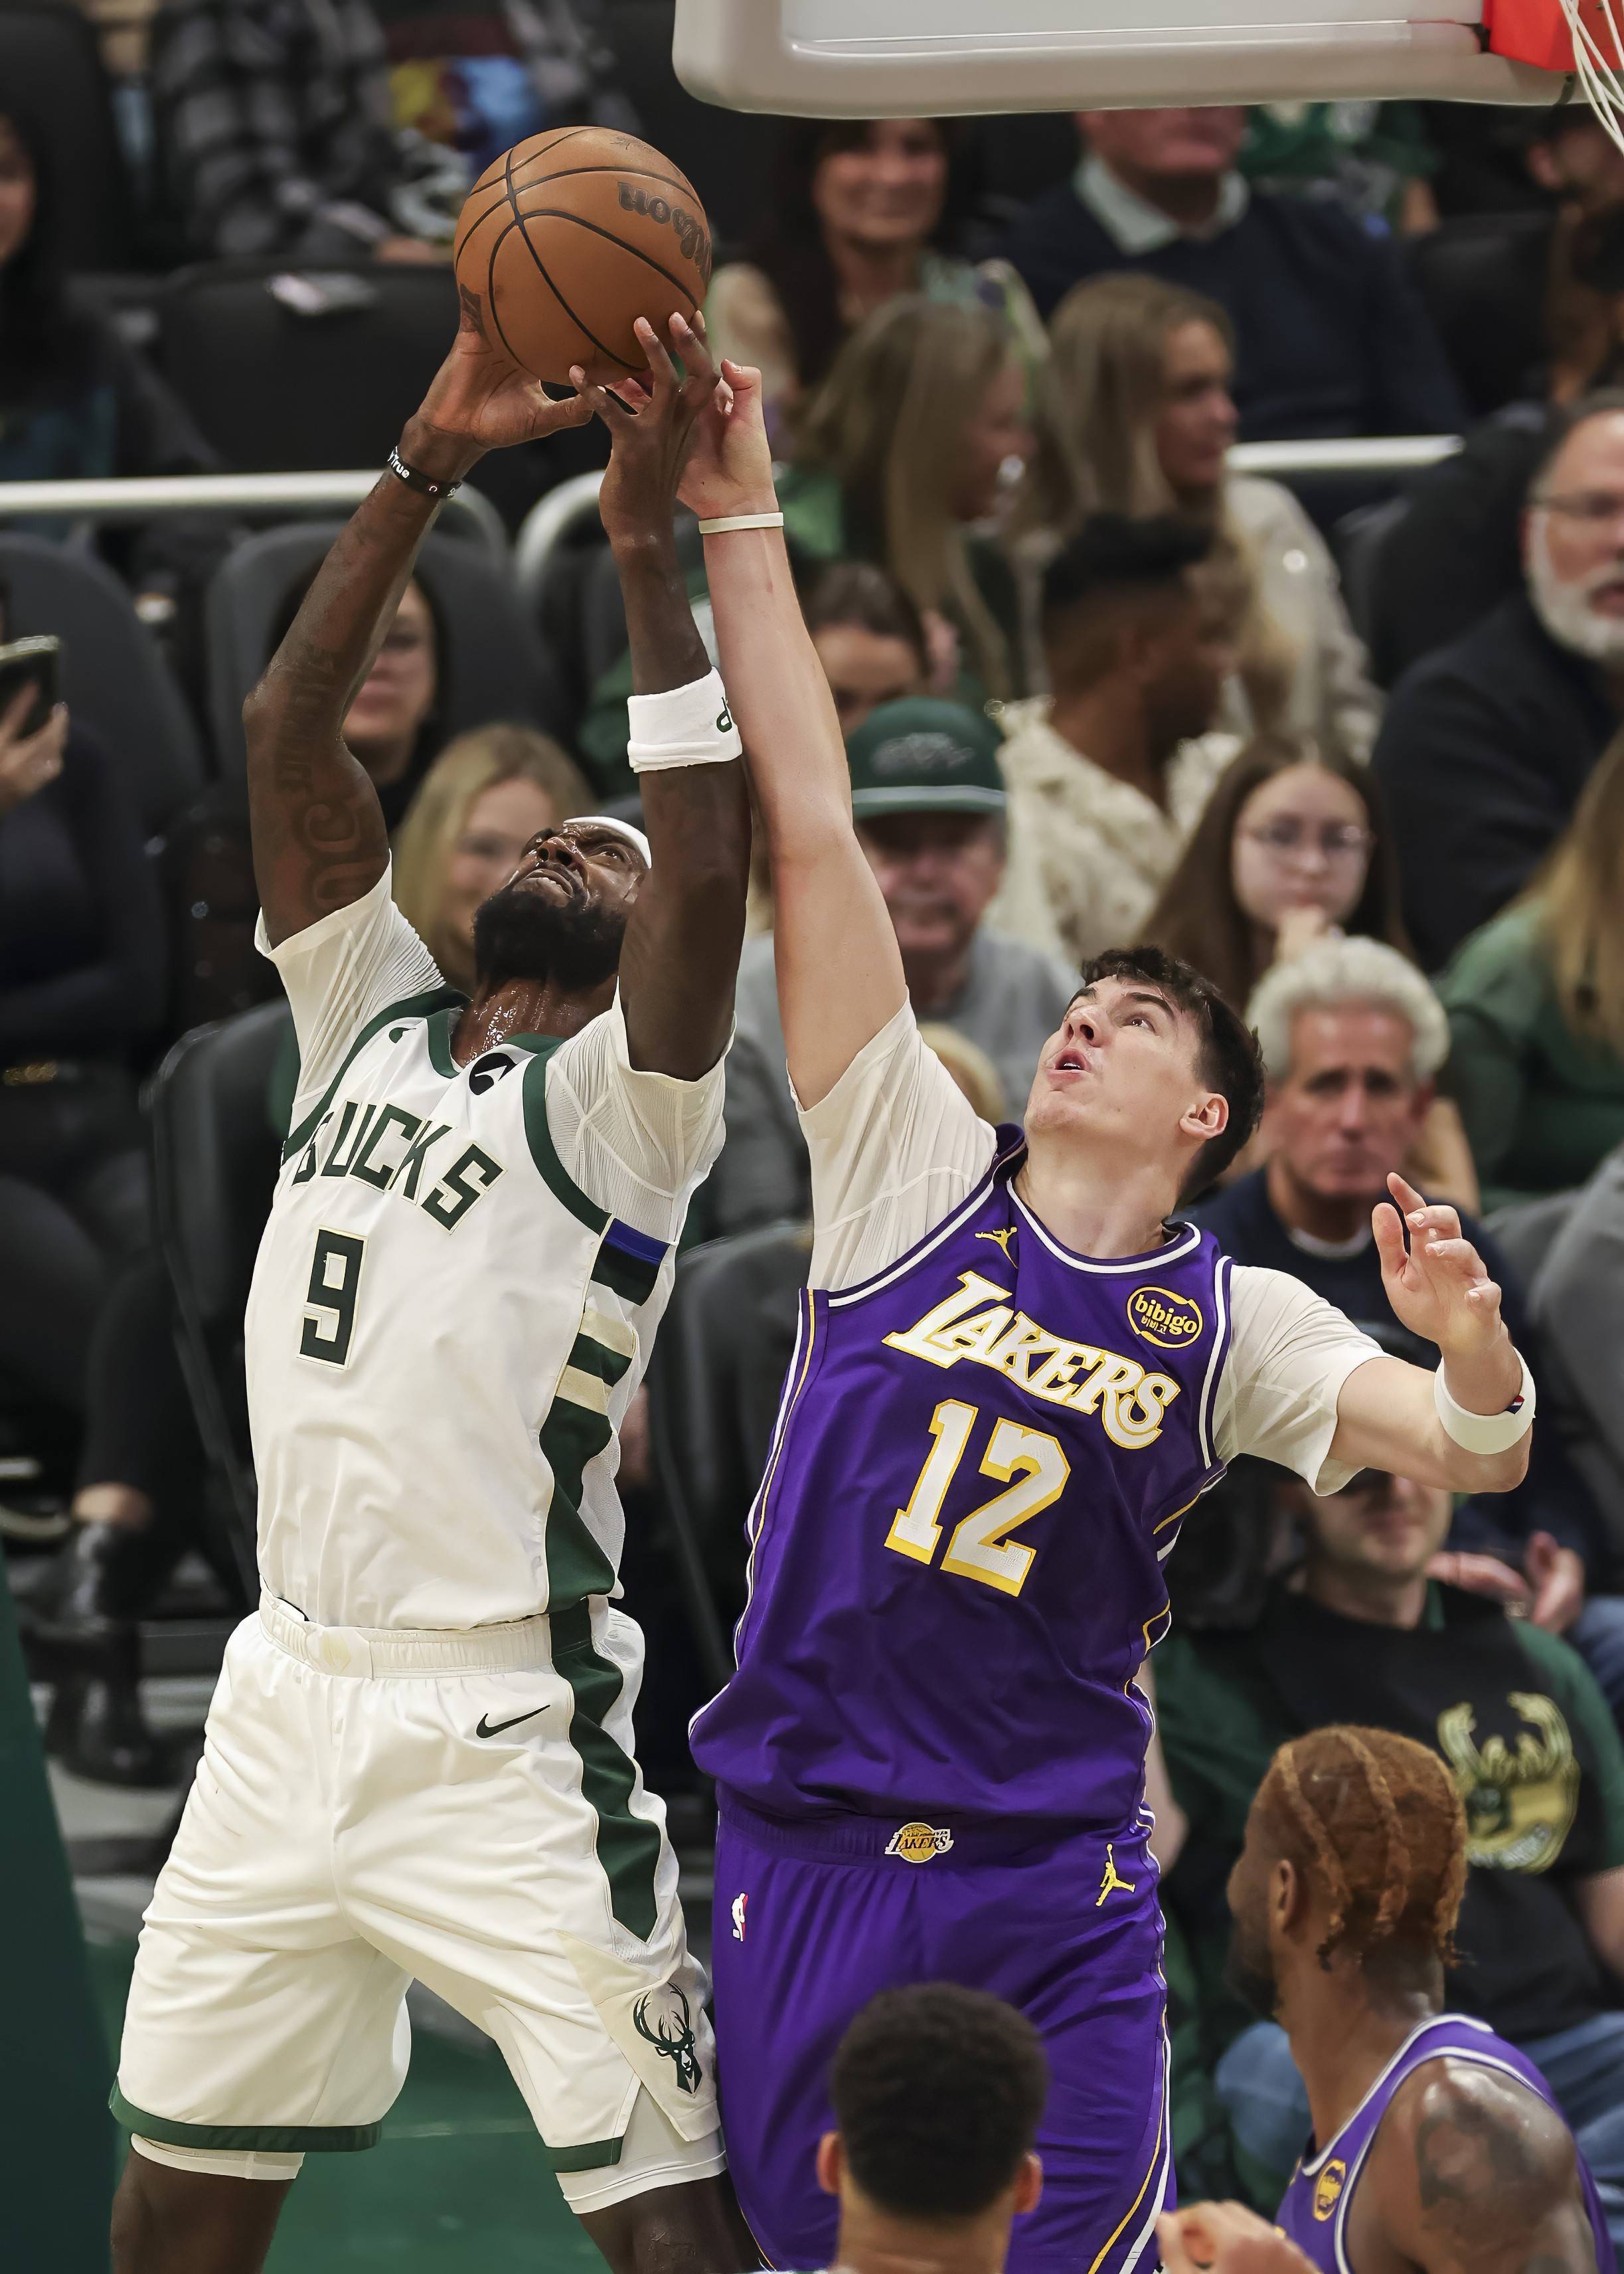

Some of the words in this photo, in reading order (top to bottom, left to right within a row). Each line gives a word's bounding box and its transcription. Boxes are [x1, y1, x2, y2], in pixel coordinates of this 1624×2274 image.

[297, 1225, 368, 1370] 9
[882, 1270, 1181, 1449] LAKERS
[1135, 1294, 1198, 1336] bibigo
[884, 1399, 1072, 1597] 12
[887, 1832, 949, 1852] LAKERS
